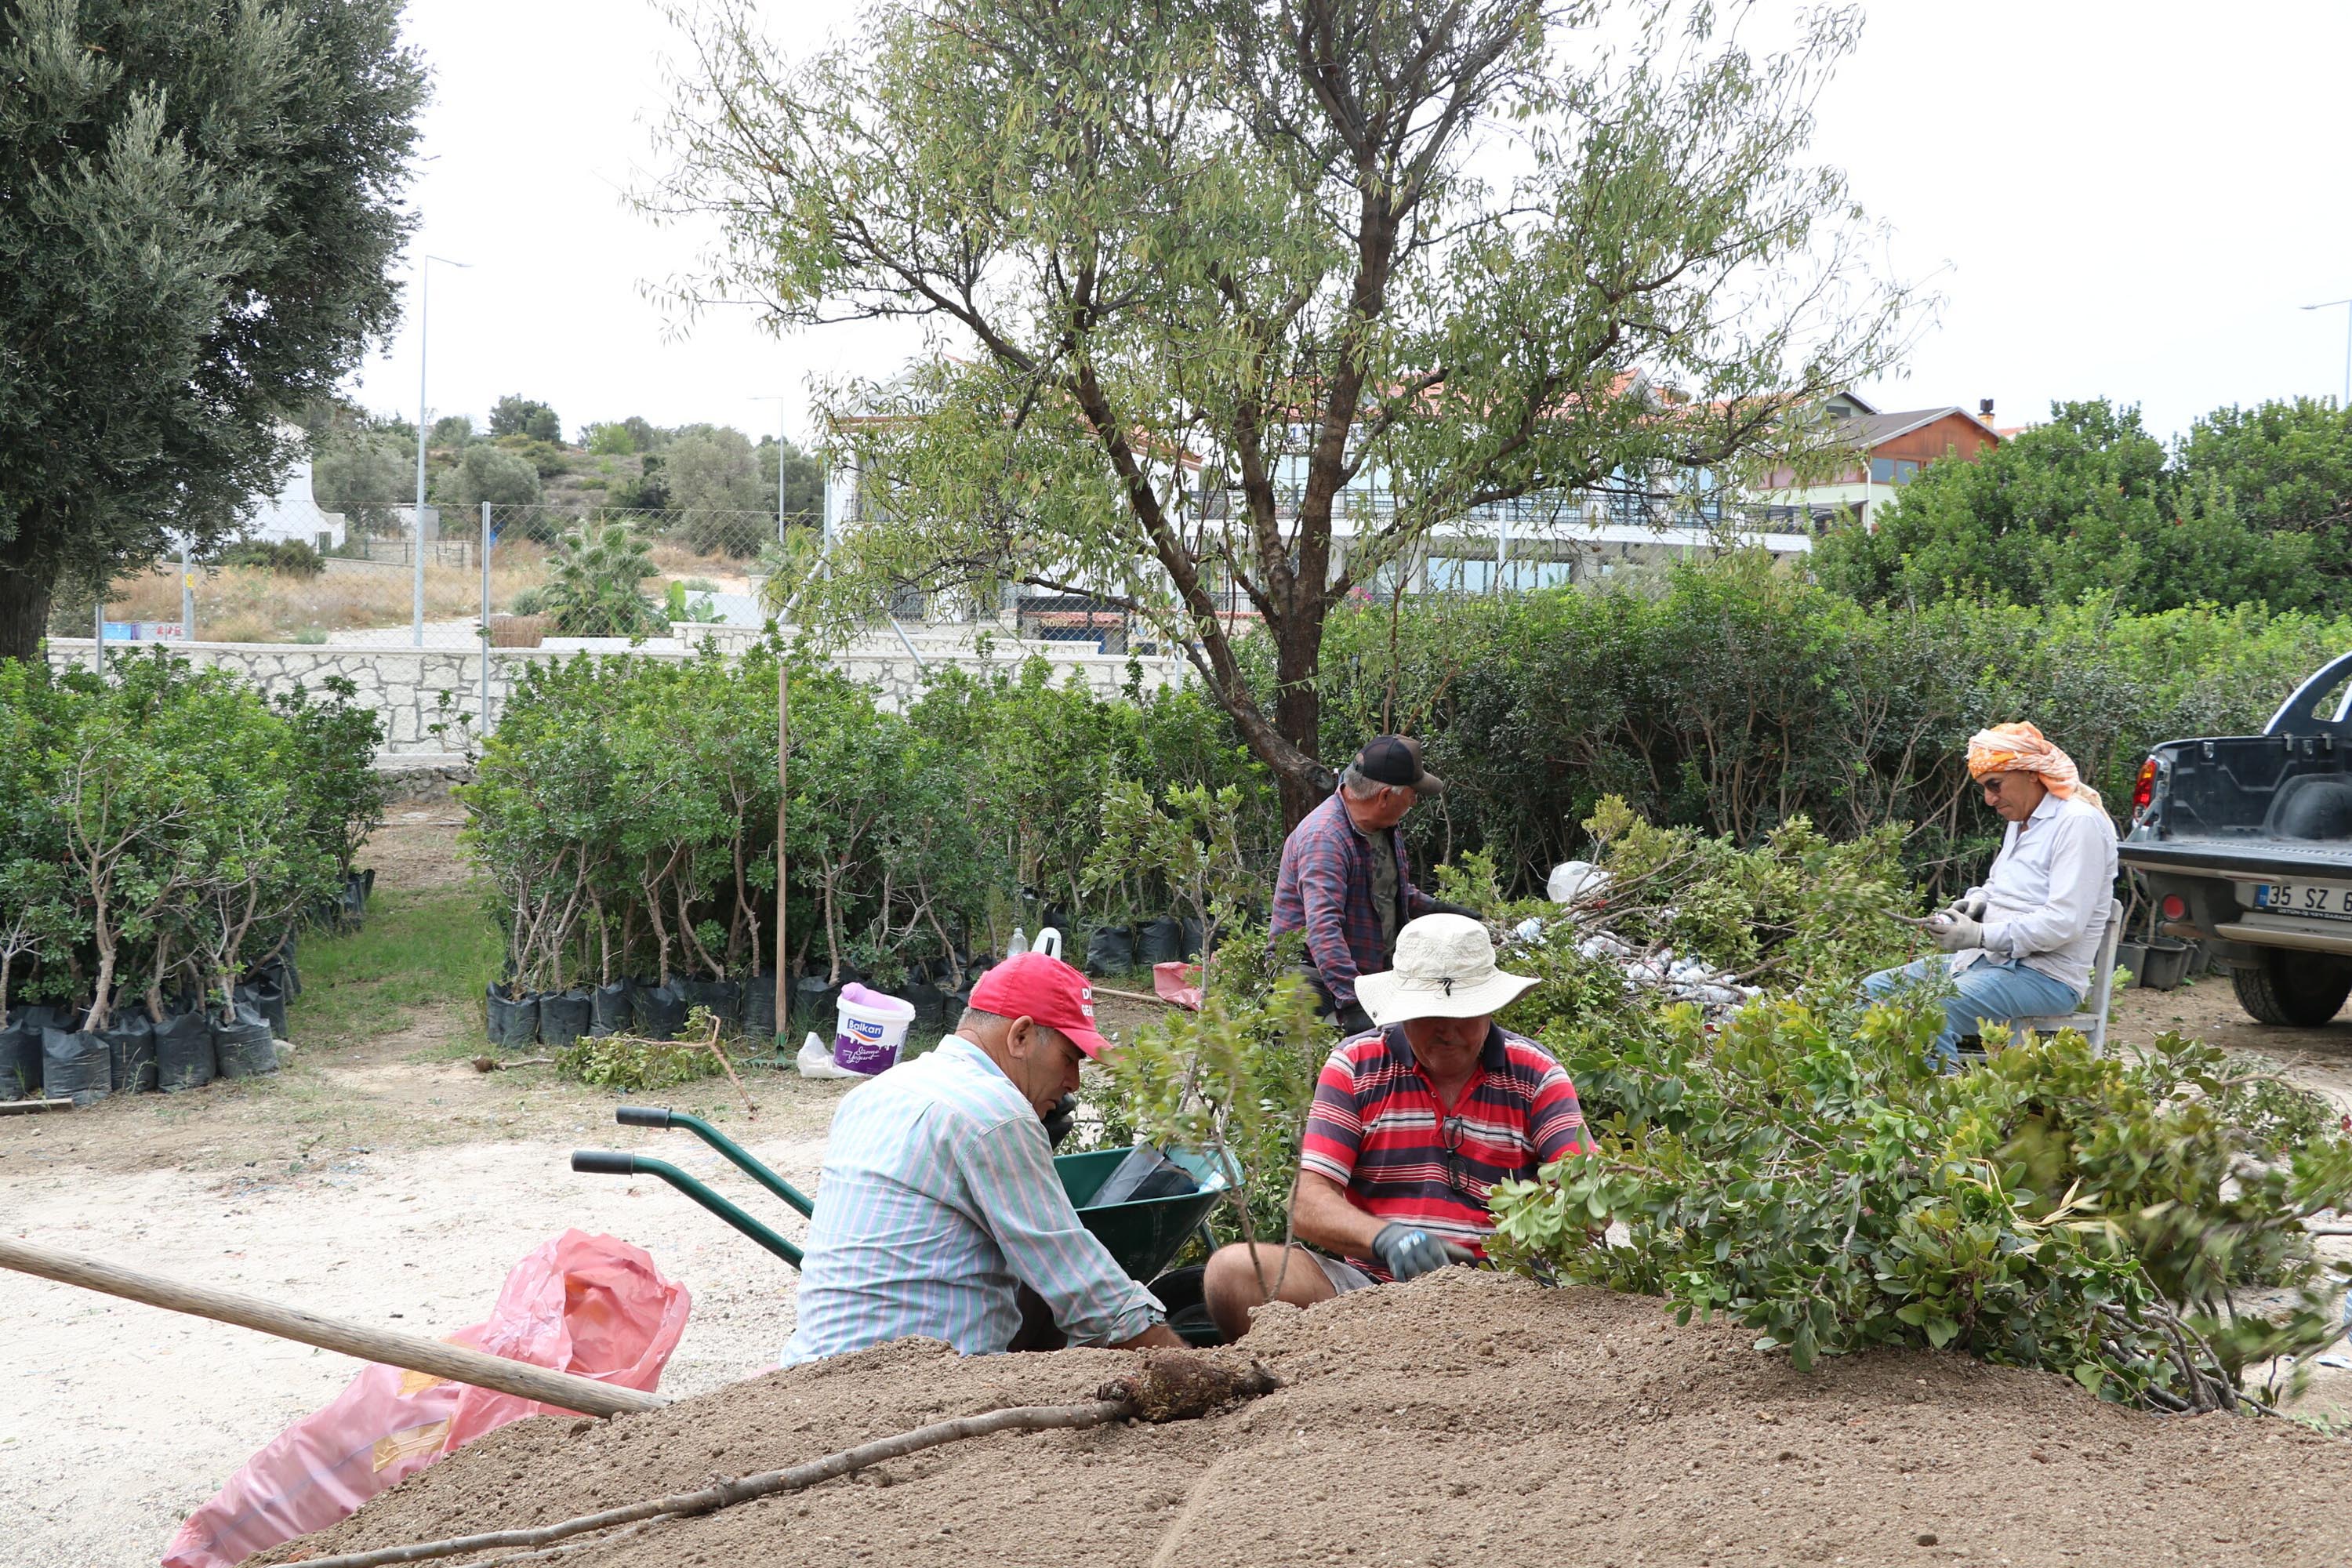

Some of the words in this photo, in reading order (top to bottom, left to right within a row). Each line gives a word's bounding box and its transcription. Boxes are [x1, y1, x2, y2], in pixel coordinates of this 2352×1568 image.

[2270, 886, 2292, 906] 35
[2305, 888, 2328, 909] SZ
[849, 1020, 881, 1034] Balkan
